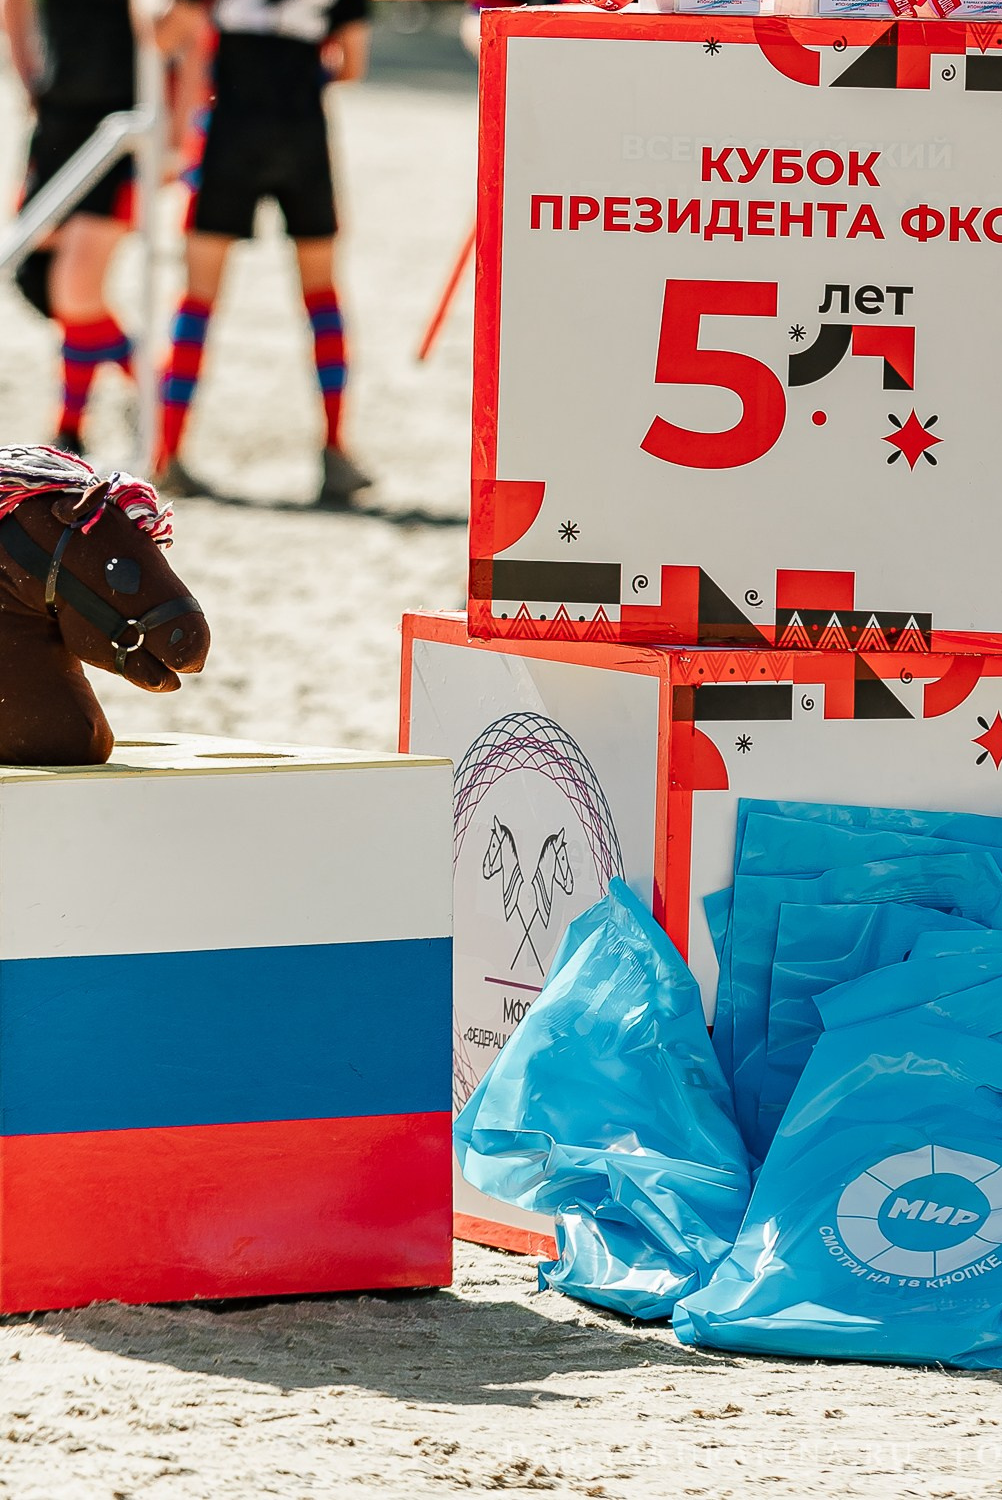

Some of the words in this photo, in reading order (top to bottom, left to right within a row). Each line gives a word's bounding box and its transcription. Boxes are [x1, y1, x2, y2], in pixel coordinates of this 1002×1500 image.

[700, 146, 883, 188] КУБОК
[529, 194, 886, 242] ПРЕЗИДЕНТА
[639, 278, 787, 471] 5
[818, 283, 914, 316] лет
[887, 1197, 980, 1227] МИР
[819, 1225, 867, 1277] СМОТРИ
[866, 1271, 892, 1285] НА
[898, 1278, 920, 1288] 18
[926, 1254, 1002, 1288] КНОПКЕ
